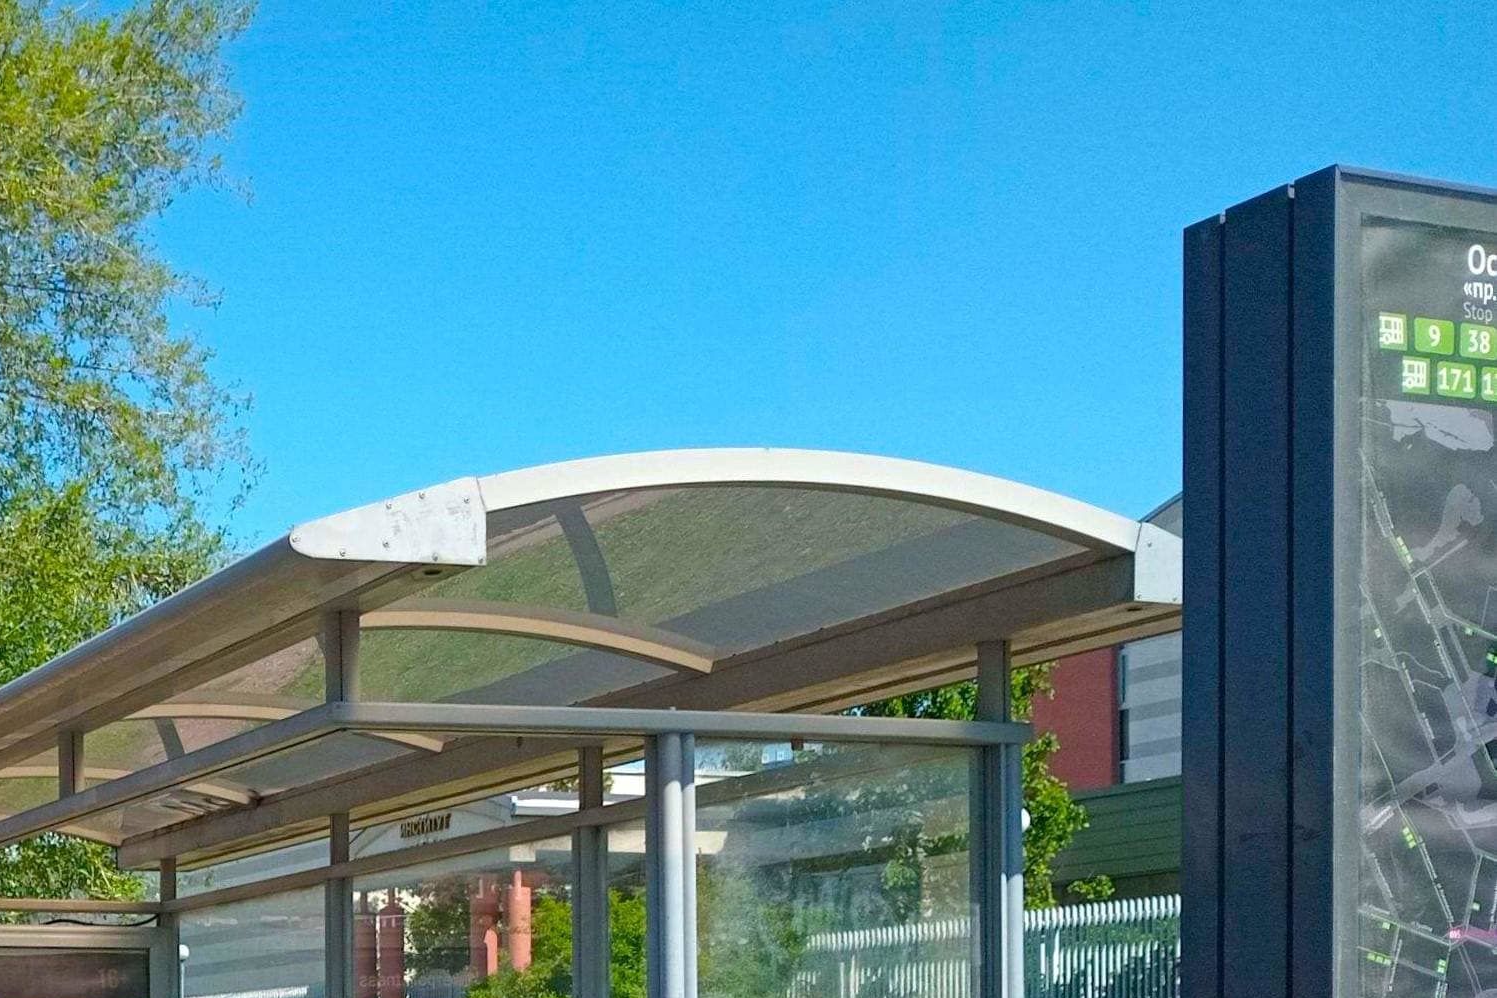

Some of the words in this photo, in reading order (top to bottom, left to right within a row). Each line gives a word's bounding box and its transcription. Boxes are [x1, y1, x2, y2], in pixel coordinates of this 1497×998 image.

[1463, 302, 1493, 324] Stop
[1428, 325, 1441, 347] 9
[1468, 329, 1491, 354] 38
[1438, 367, 1473, 393] 171
[1484, 373, 1497, 395] 1
